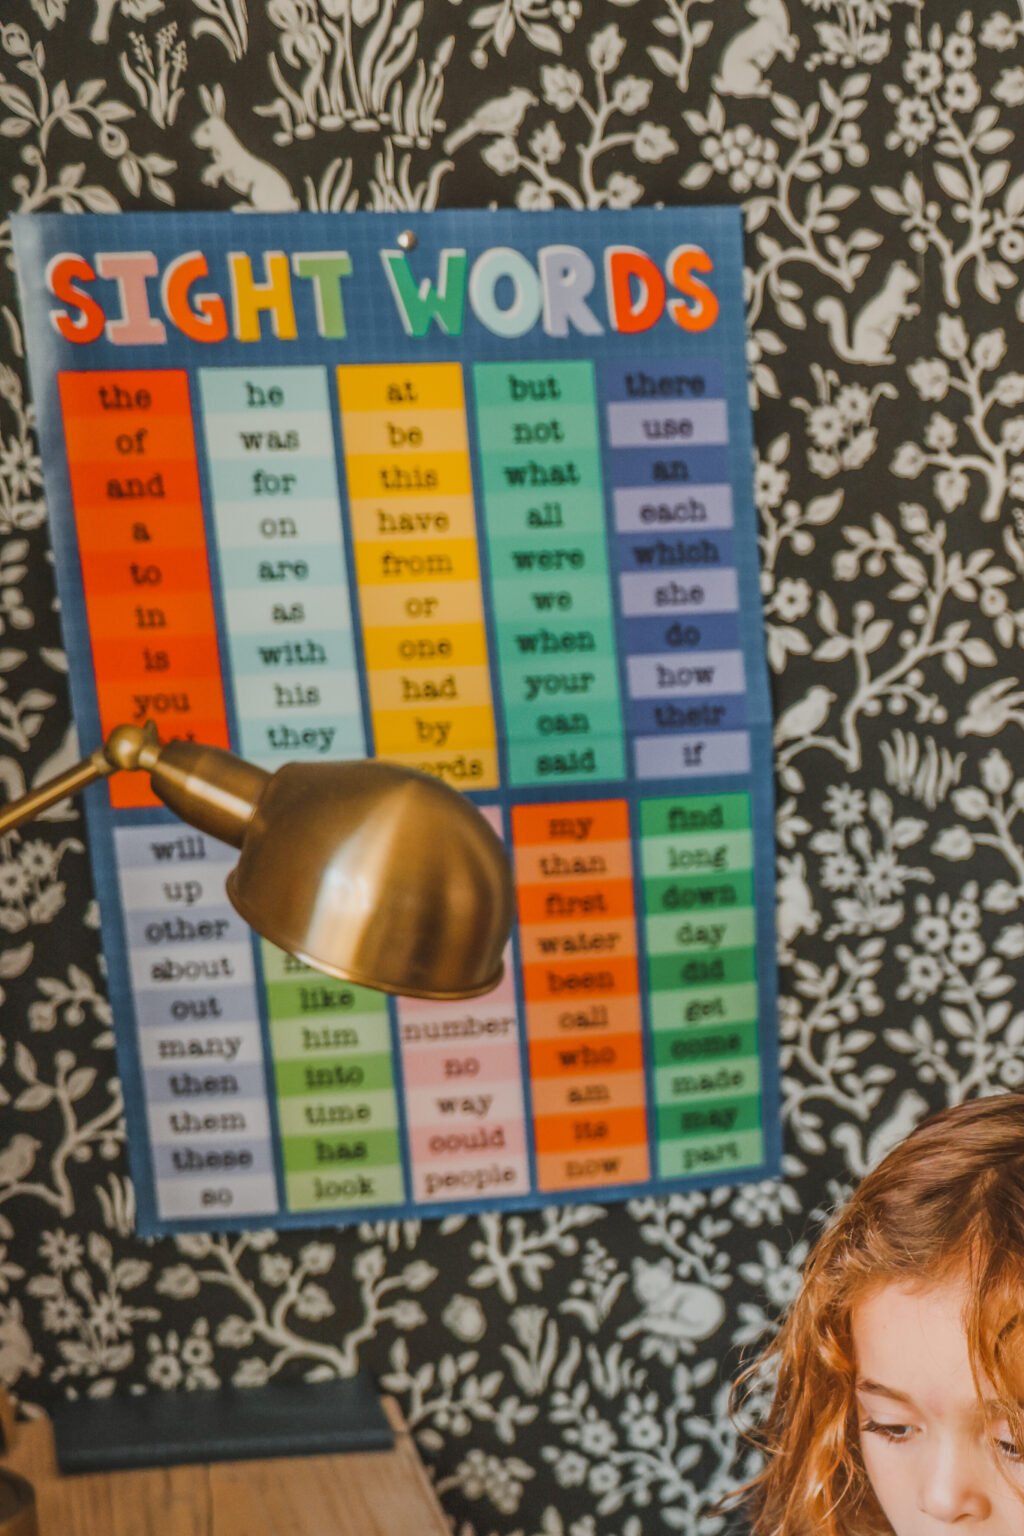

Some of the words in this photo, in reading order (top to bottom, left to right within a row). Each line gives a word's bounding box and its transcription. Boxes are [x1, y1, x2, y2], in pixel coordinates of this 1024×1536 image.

[45, 250, 352, 346] SIGHT
[380, 244, 719, 338] WORDS
[246, 382, 284, 408] he
[386, 381, 417, 401] at
[509, 374, 560, 401] but
[625, 371, 705, 397] there
[98, 384, 151, 411] the
[388, 421, 422, 448] be
[513, 418, 564, 444] not
[642, 417, 693, 438] use
[116, 429, 147, 455] of
[240, 430, 299, 451] was
[254, 470, 296, 496] for
[380, 466, 437, 490] this
[504, 460, 580, 488] what
[653, 460, 688, 481] an
[107, 474, 164, 499] and
[378, 510, 449, 534] have
[527, 502, 563, 529] all
[639, 498, 707, 524] each
[132, 521, 151, 542] a
[260, 517, 296, 537] on
[381, 552, 452, 575] from
[512, 548, 584, 571] were
[632, 540, 720, 566] which
[130, 564, 161, 585] to
[258, 560, 308, 582] are
[531, 591, 572, 611] we
[655, 581, 704, 606] she
[136, 606, 166, 628] in
[273, 604, 304, 623] as
[405, 597, 438, 618] or
[515, 630, 594, 655] when
[665, 624, 701, 647] do
[144, 649, 169, 671] is
[259, 639, 326, 667] with
[399, 637, 452, 660] one
[402, 675, 457, 701] had
[525, 671, 594, 699] your
[657, 663, 715, 688] how
[133, 693, 189, 718] you
[275, 683, 319, 708] his
[537, 712, 589, 734] can
[655, 704, 726, 728] their
[267, 725, 335, 751] they
[415, 717, 451, 745] by
[536, 748, 595, 776] said
[683, 742, 704, 766] if
[420, 756, 483, 779] ords
[549, 815, 593, 841] my
[667, 805, 723, 831] find
[151, 837, 205, 862] will
[539, 850, 606, 874] than
[667, 845, 728, 871] long
[163, 880, 202, 907] up
[546, 891, 607, 917] first
[663, 884, 736, 909] down
[145, 917, 227, 944] other
[538, 930, 621, 954] water
[676, 922, 726, 946] day
[151, 954, 233, 981] about
[681, 959, 725, 982] did
[547, 969, 614, 993] been
[171, 996, 221, 1020] out
[299, 987, 354, 1012] like
[685, 997, 726, 1021] get
[404, 1014, 515, 1043] number
[559, 1005, 608, 1029] call
[158, 1034, 241, 1062] many
[303, 1025, 358, 1049] him
[671, 1033, 741, 1056] come
[558, 1041, 616, 1066] who
[304, 1062, 363, 1089] into
[444, 1056, 479, 1079] no
[168, 1073, 238, 1096] then
[568, 1084, 609, 1102] am
[673, 1068, 744, 1094] made
[304, 1101, 370, 1124] time
[436, 1093, 492, 1118] way
[169, 1110, 245, 1132] them
[574, 1117, 607, 1142] its
[681, 1107, 737, 1131] may
[315, 1138, 366, 1164] has
[429, 1128, 505, 1153] could
[171, 1147, 252, 1173] these
[566, 1154, 621, 1176] now
[683, 1143, 738, 1169] part
[314, 1175, 373, 1200] look
[424, 1165, 515, 1194] people
[201, 1185, 232, 1207] so
